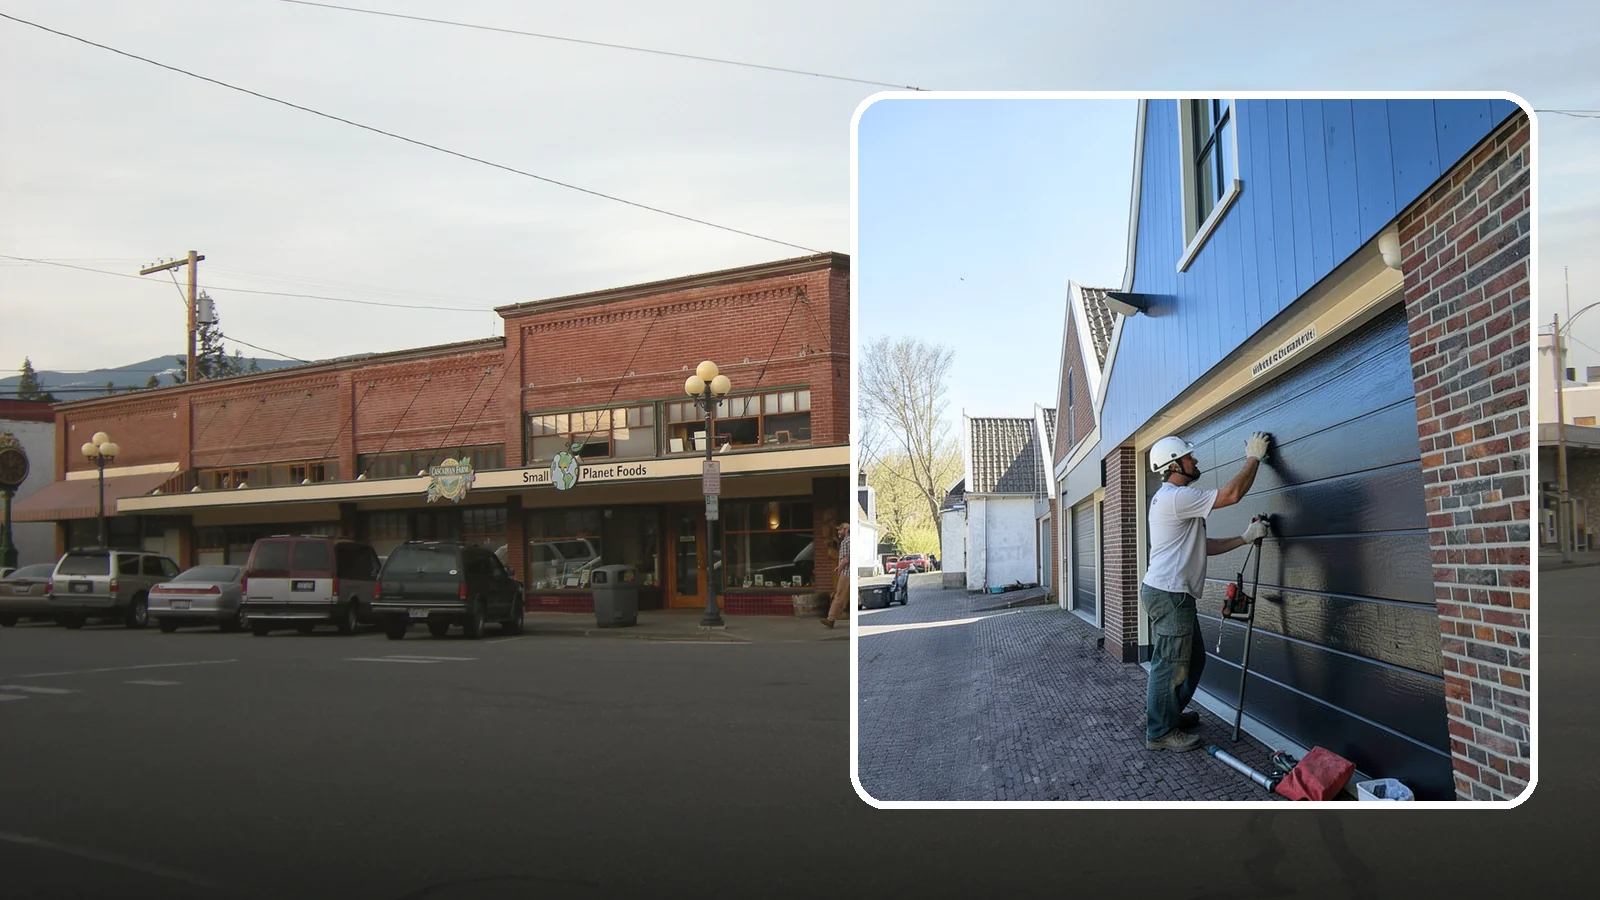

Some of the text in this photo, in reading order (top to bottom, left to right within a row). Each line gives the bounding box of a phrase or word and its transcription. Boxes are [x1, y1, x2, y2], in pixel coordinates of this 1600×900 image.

[431, 466, 469, 476] CASCADIAN FARM
[523, 464, 647, 482] Small Planet Foods
